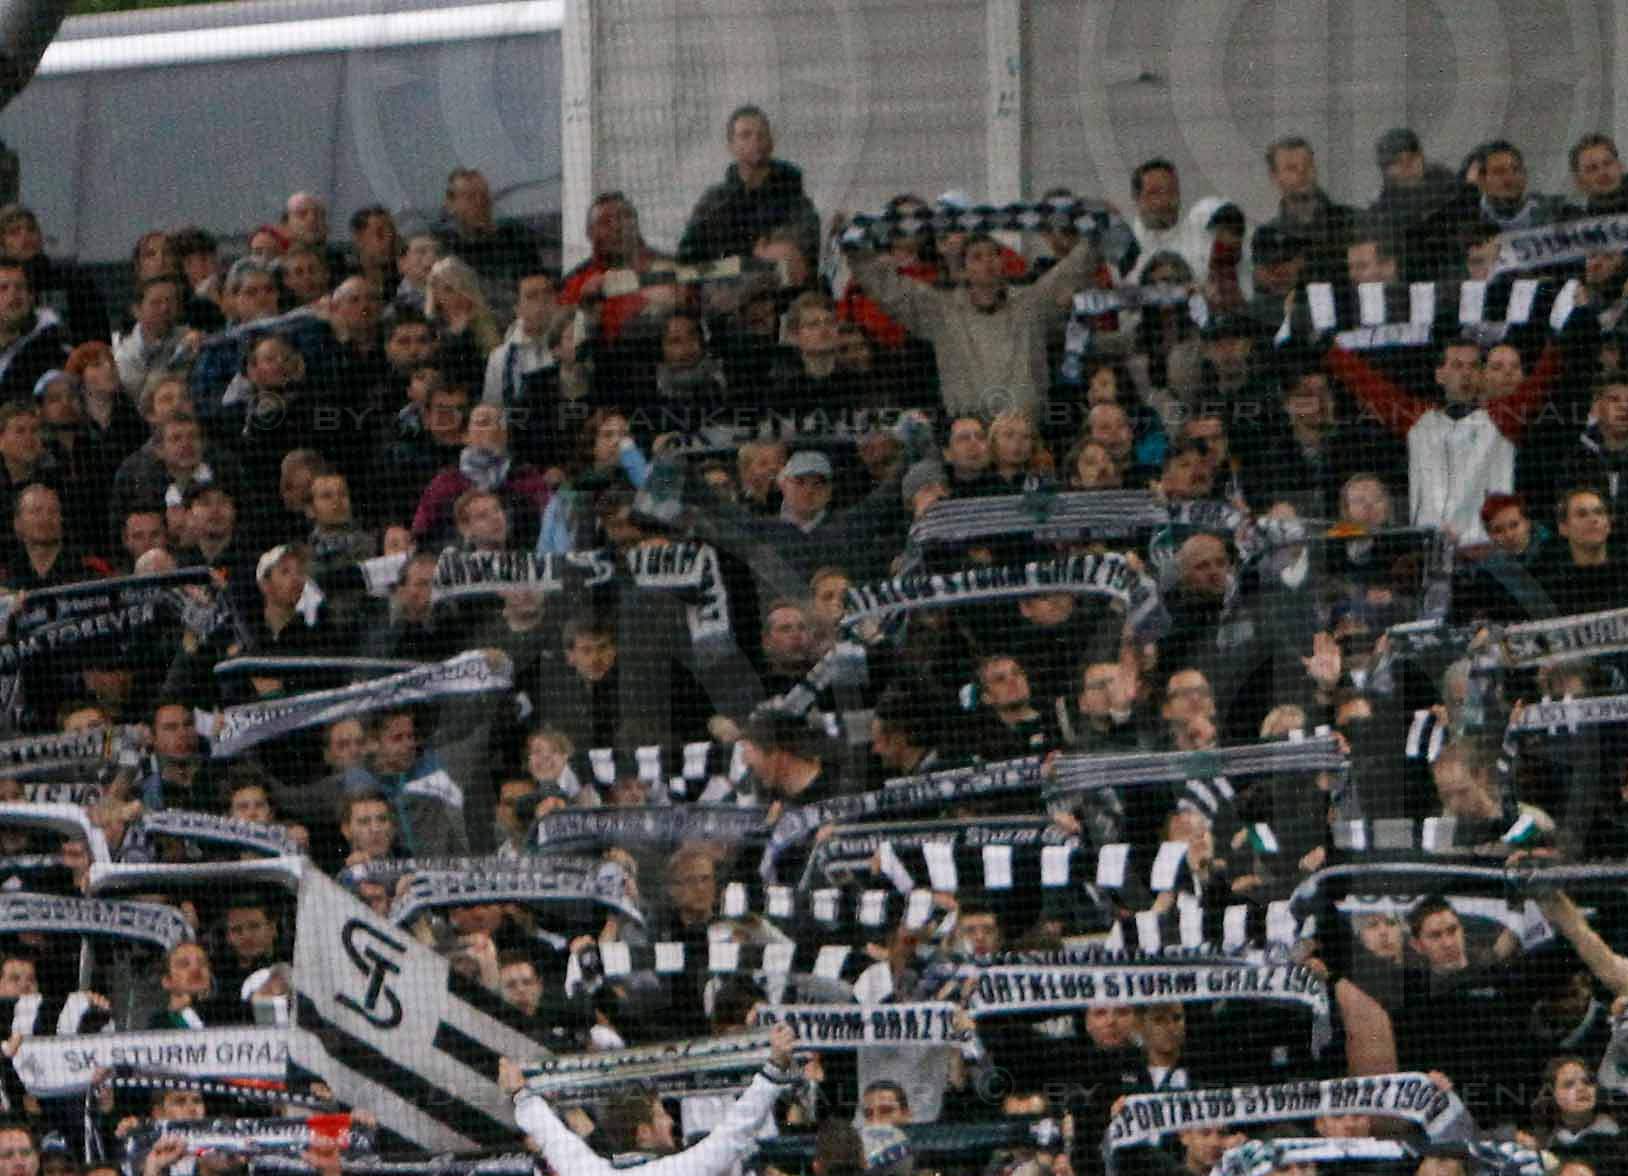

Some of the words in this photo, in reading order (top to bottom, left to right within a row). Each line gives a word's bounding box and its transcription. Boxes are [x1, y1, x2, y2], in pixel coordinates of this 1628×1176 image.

[976, 971, 1096, 1004] ORTKLUB
[64, 1048, 98, 1074] SK
[110, 1044, 205, 1070] STURM
[1245, 1085, 1324, 1119] STURM
